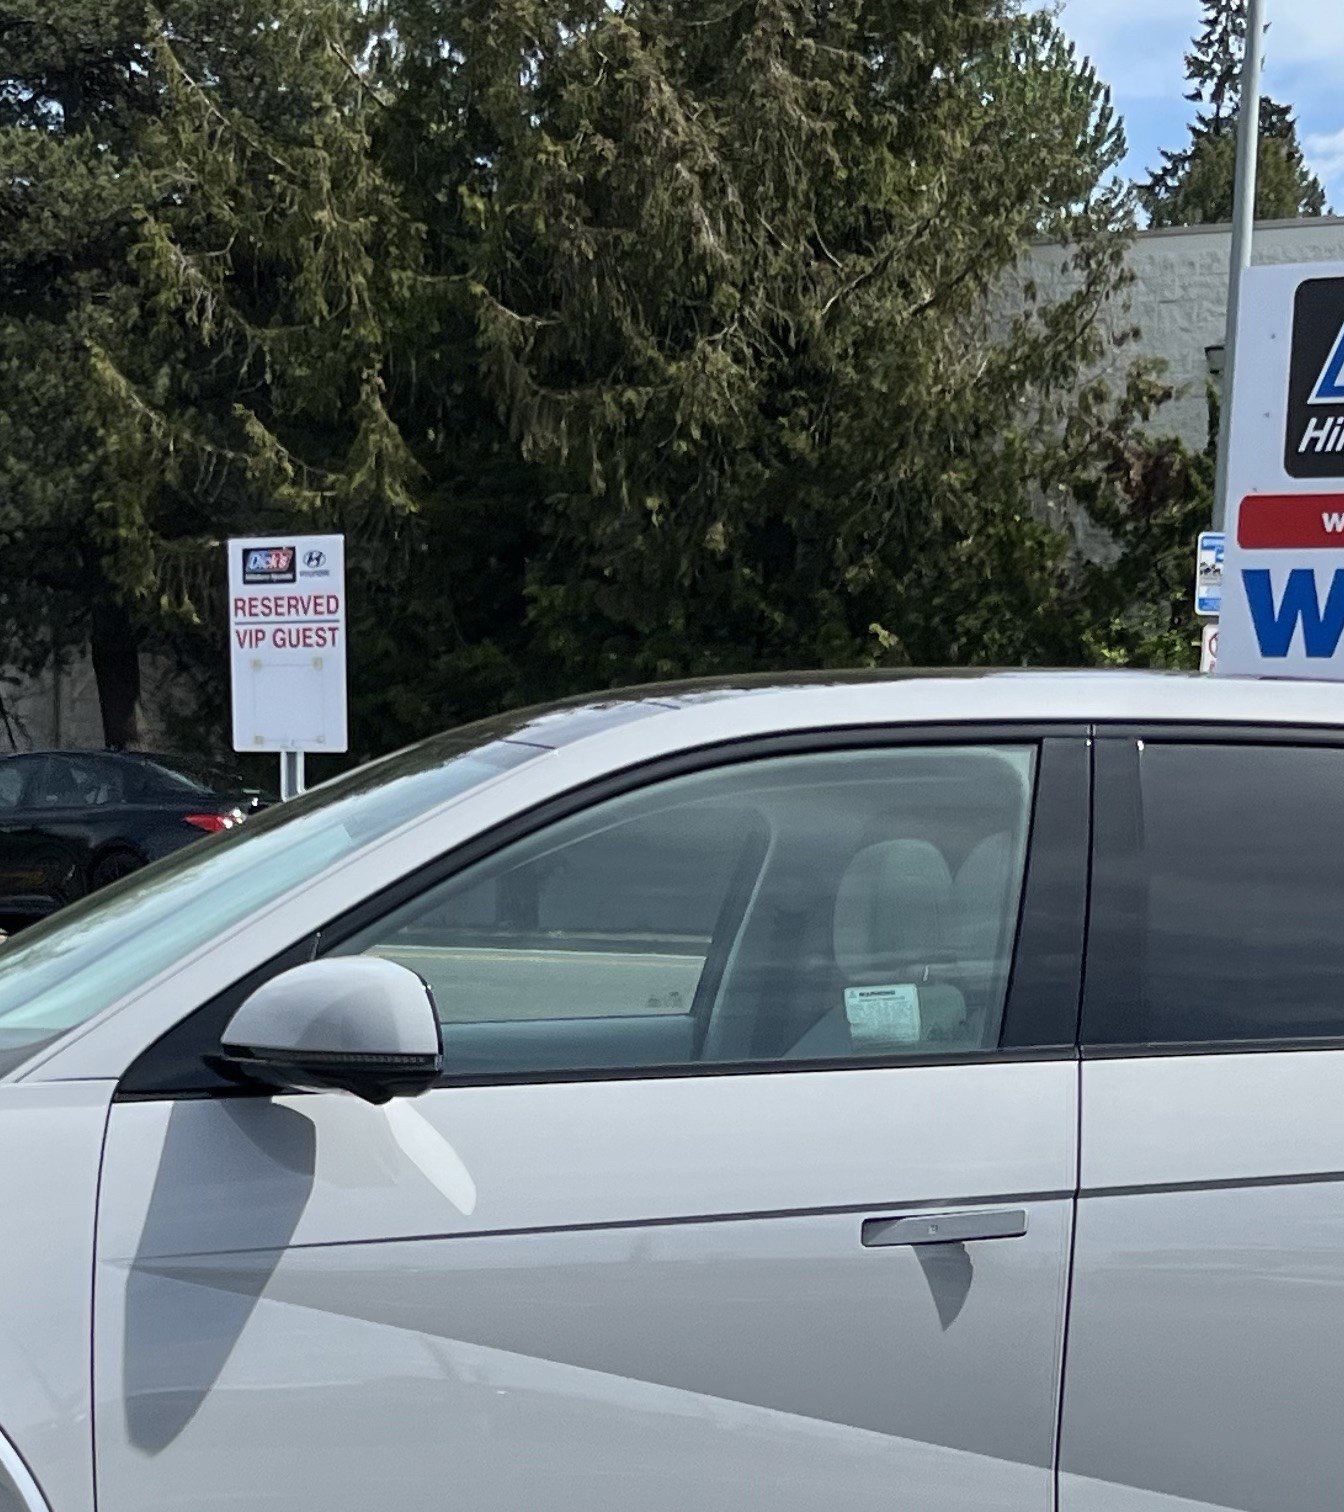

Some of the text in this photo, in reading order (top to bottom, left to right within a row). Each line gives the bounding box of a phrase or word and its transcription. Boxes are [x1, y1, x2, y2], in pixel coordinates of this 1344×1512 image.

[233, 594, 340, 618] RESERVED
[235, 626, 340, 649] VIP GUEST
